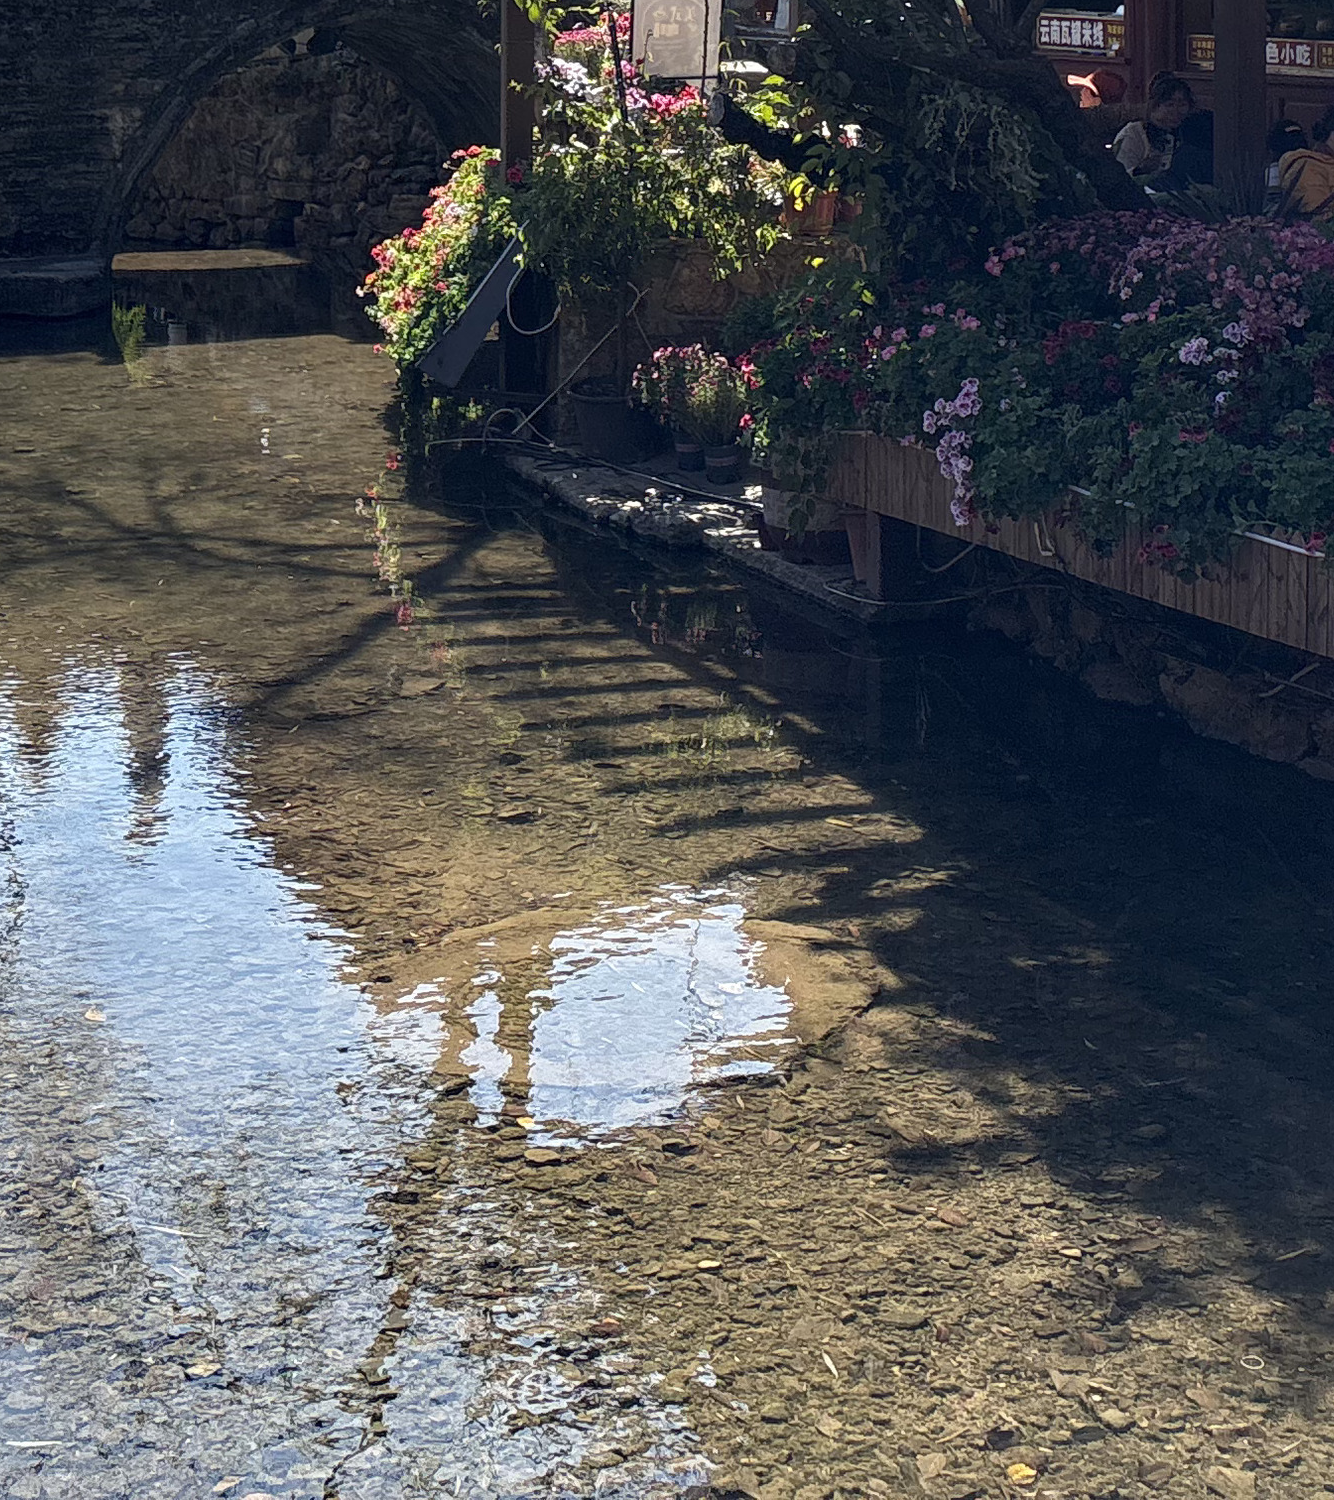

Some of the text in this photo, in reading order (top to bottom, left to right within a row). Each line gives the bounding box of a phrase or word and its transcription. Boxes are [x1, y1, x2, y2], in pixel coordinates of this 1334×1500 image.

[1039, 19, 1105, 48] 云南瓦罐米线
